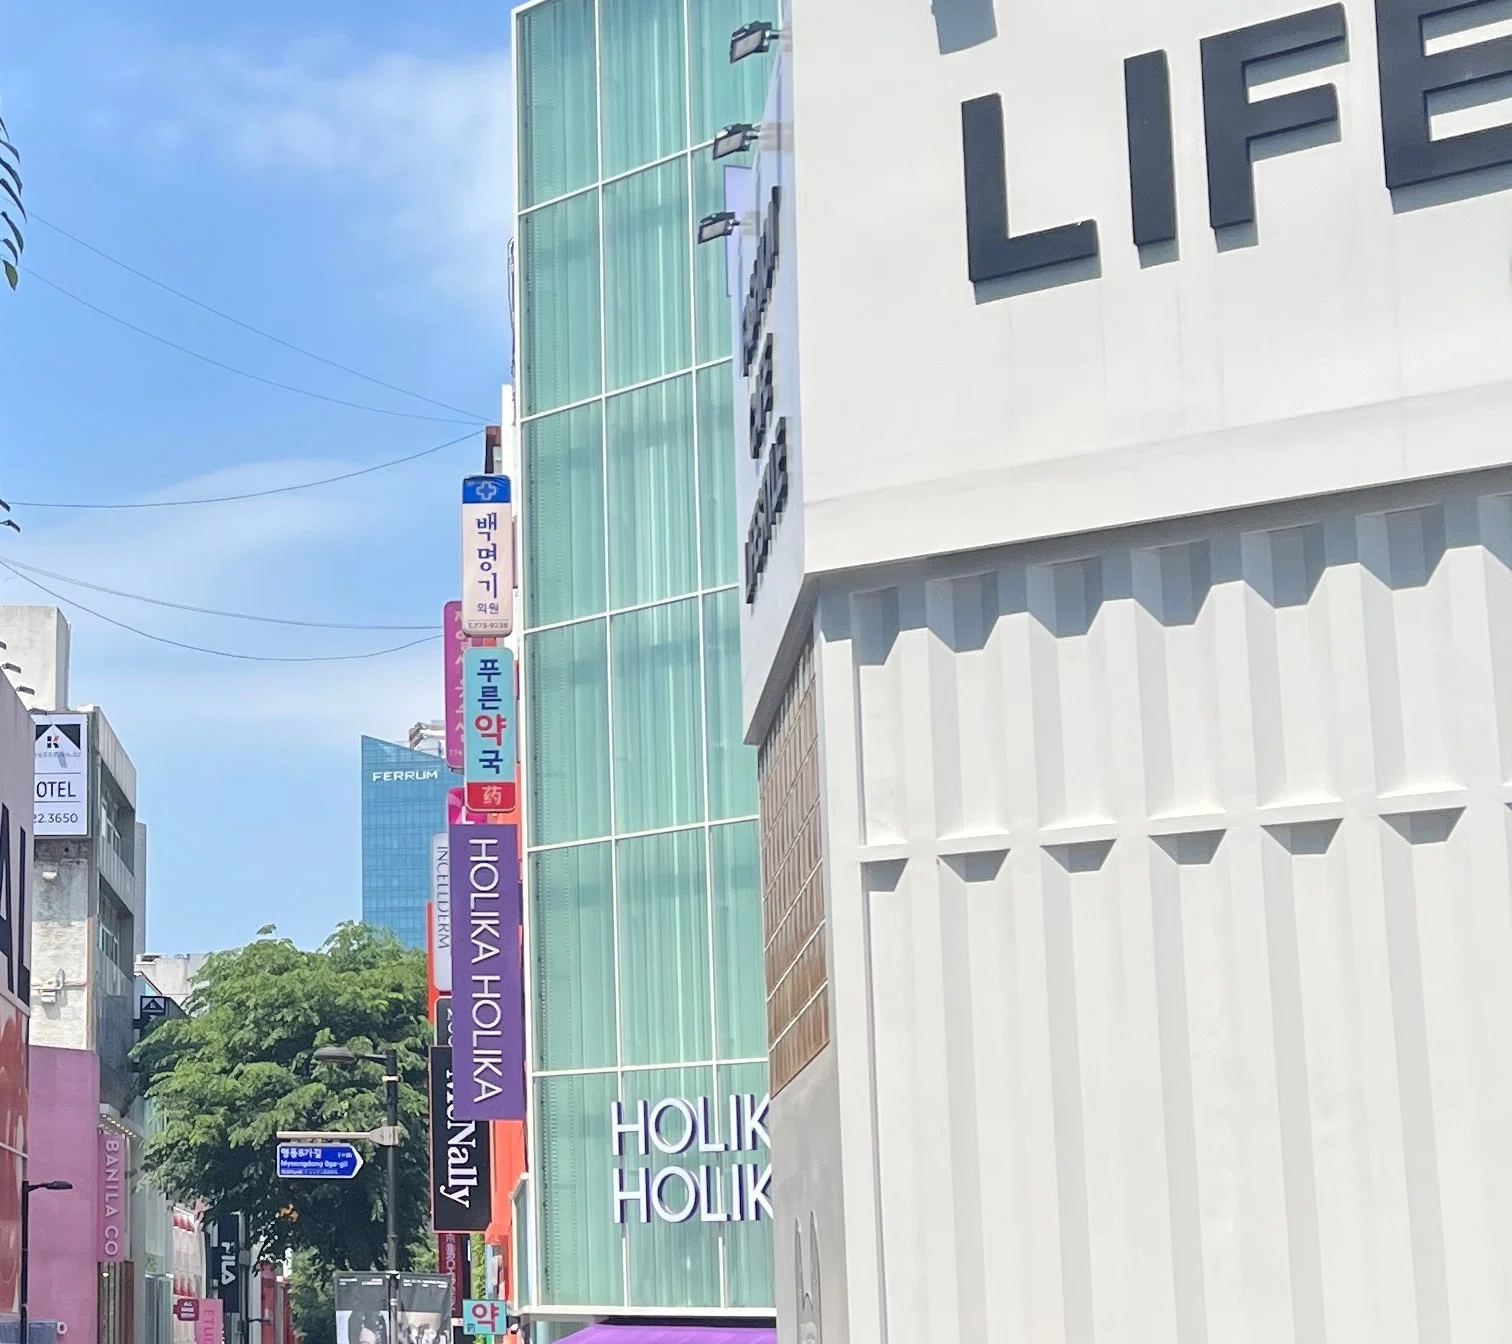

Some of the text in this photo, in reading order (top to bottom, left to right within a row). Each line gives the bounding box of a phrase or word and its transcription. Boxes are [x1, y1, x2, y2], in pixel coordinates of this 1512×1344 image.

[476, 512, 498, 600] 백명기
[474, 658, 507, 775] 푸른약국
[372, 769, 438, 782] FERRUM
[437, 845, 451, 950] INCELLDERM
[468, 838, 504, 1104] HOLIKA HOLIKA
[439, 1069, 479, 1209] Nally
[610, 1092, 771, 1156] HOLIK
[104, 1139, 120, 1257] BANILA CO
[612, 1162, 774, 1224] HOLIK
[221, 1241, 236, 1286] FILA
[471, 1302, 500, 1333] 약
